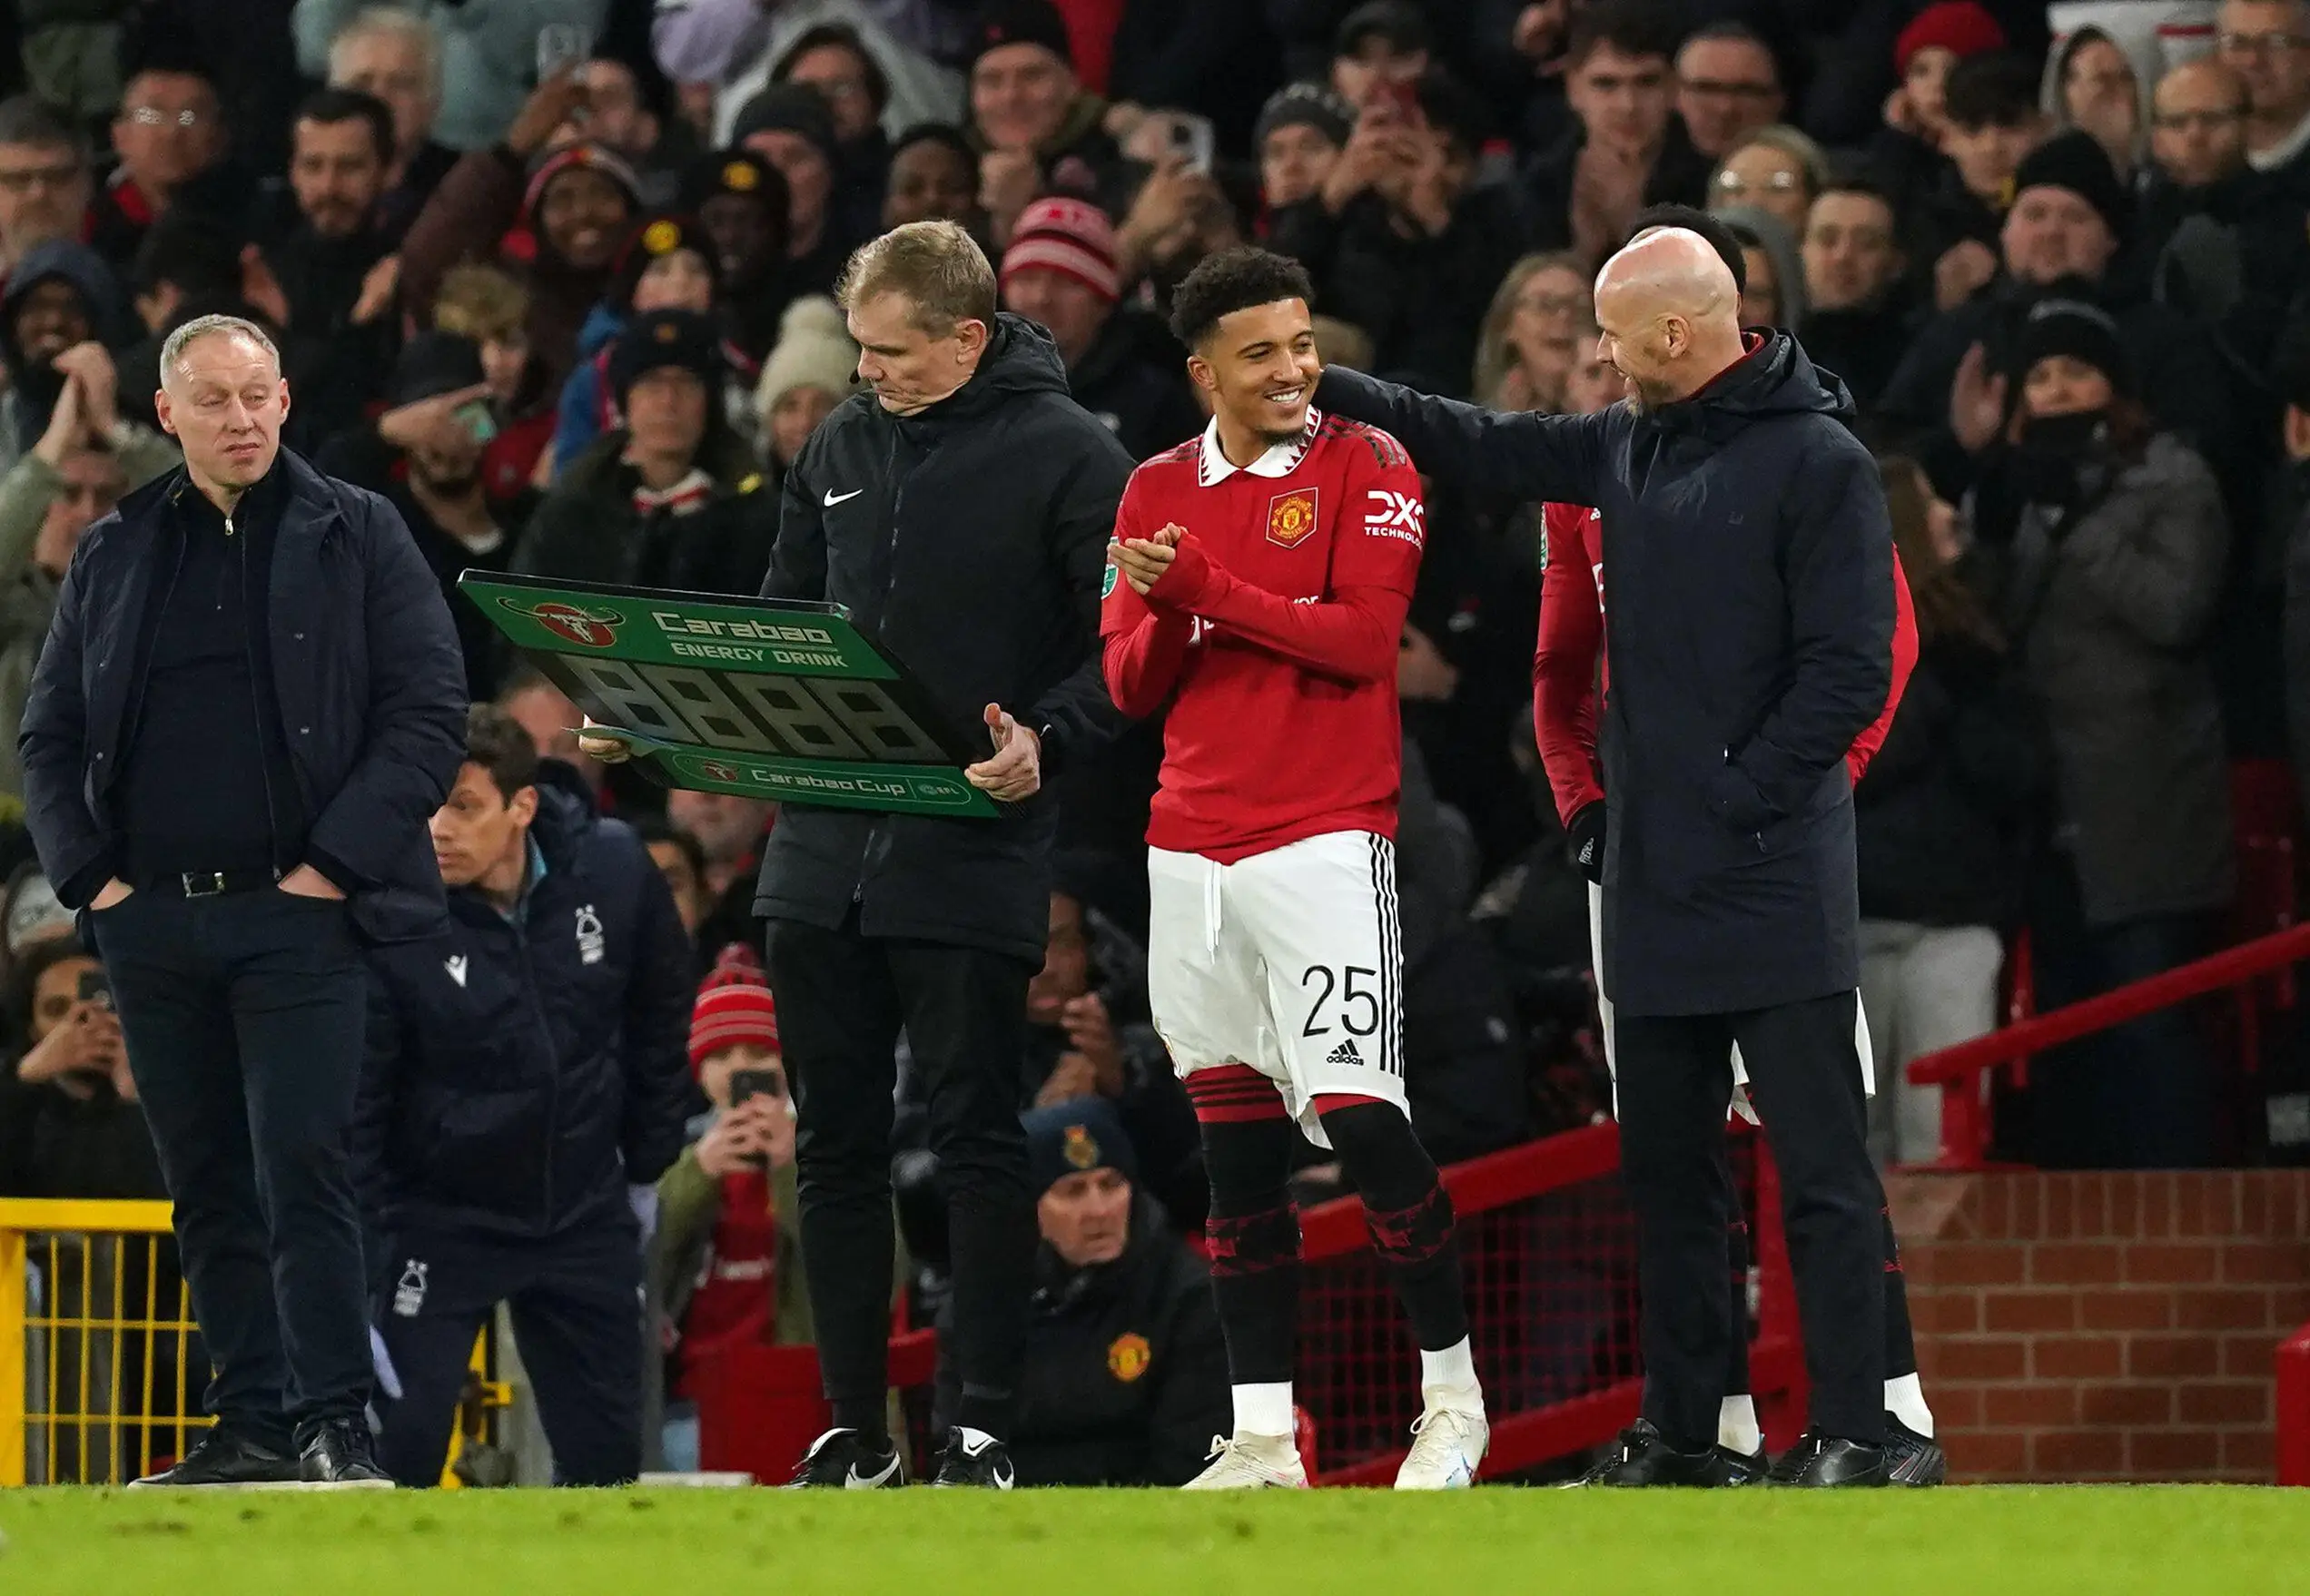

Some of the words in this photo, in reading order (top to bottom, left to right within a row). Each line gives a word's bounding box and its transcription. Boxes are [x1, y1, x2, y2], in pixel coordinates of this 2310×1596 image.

[1365, 527, 1423, 551] TECHNOLO
[651, 611, 834, 645] Carabao
[670, 642, 764, 662] ENERGY
[773, 650, 849, 668] DRINK
[1302, 965, 1378, 1037] 25
[1326, 1053, 1364, 1066] adidas
